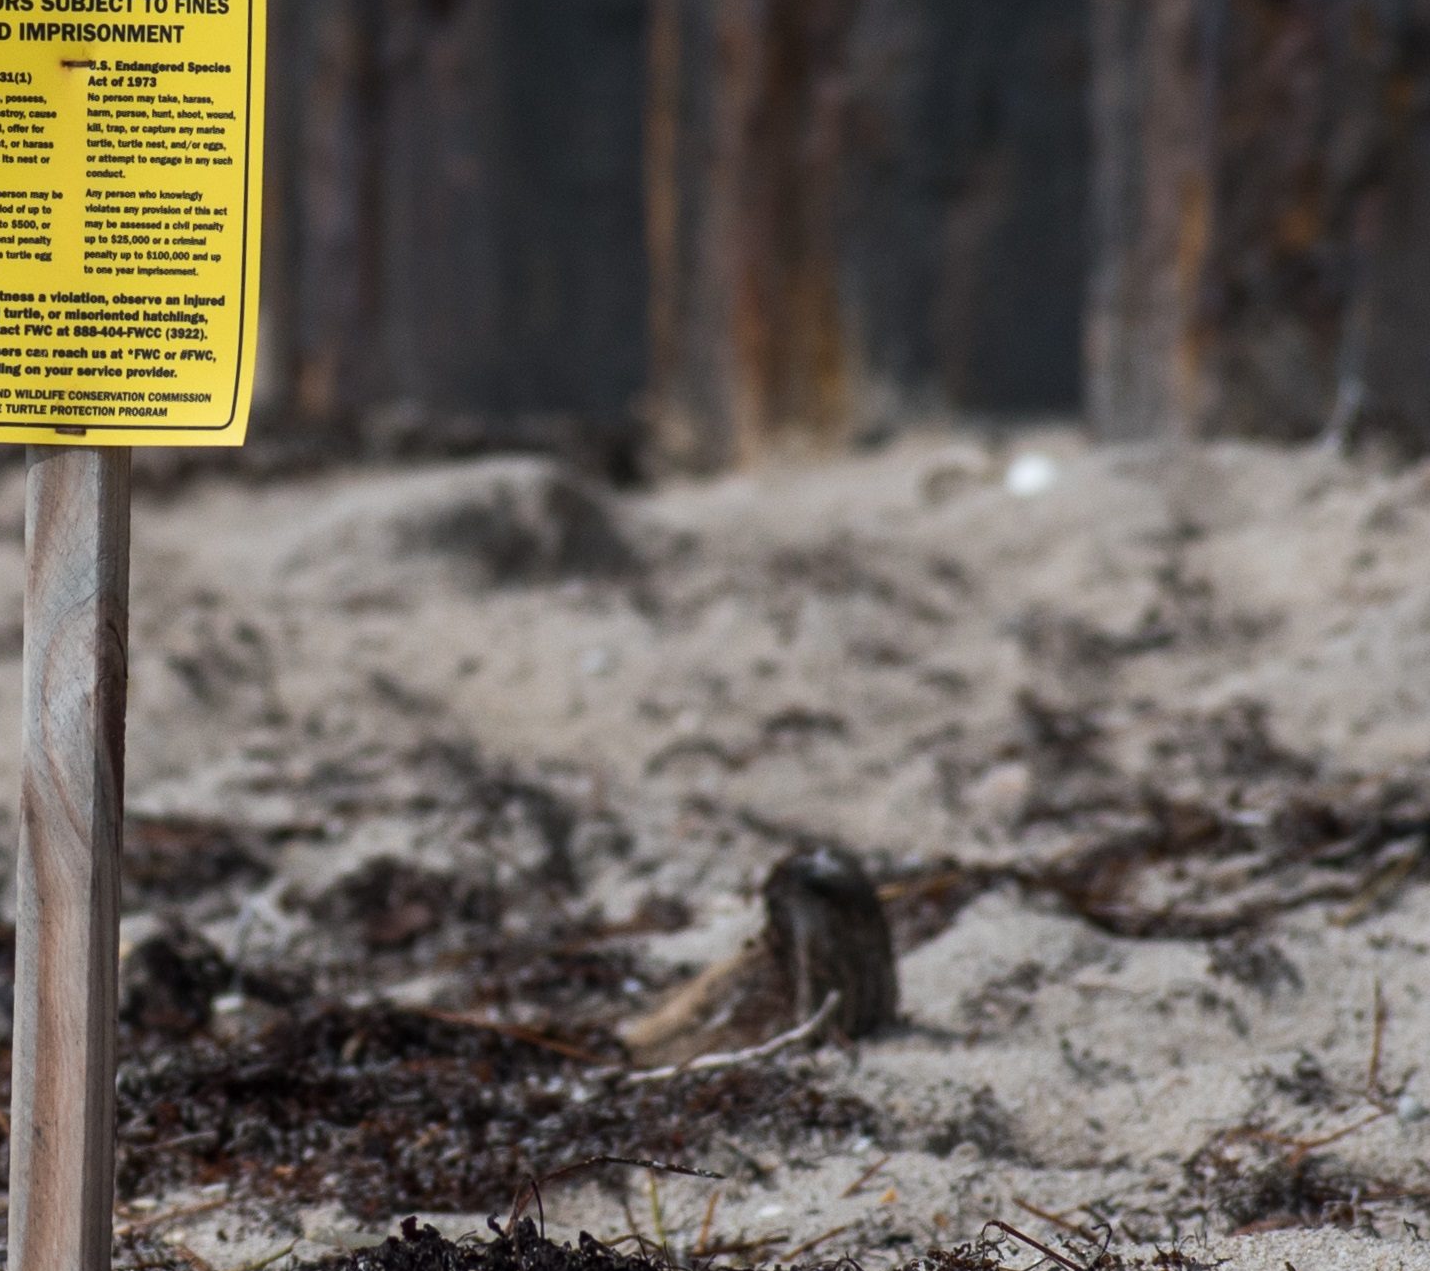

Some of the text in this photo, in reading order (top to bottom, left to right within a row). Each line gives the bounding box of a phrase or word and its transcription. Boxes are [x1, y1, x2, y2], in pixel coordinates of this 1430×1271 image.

[19, 22, 185, 43] IMPRISONMENT
[115, 60, 184, 74] Endangered
[188, 62, 231, 75] Species
[88, 76, 157, 88] Act of 1973
[87, 92, 100, 102] No
[102, 94, 134, 104] person
[136, 95, 155, 105] may
[7, 123, 29, 134] offer
[31, 124, 44, 134] for
[86, 154, 233, 166] or attempt to engage in any such
[30, 191, 49, 201] may
[52, 190, 63, 200] be
[86, 188, 203, 202] Any person who knowingly
[16, 204, 26, 214] of
[28, 206, 40, 216] up
[42, 205, 52, 214] to
[85, 203, 227, 216] violates any provision of this act
[41, 222, 51, 230] or
[84, 236, 96, 245] up
[98, 234, 108, 244] to
[111, 234, 150, 246] $25,000
[152, 237, 162, 245] or
[172, 236, 206, 246] criminal
[84, 250, 222, 263] penalty up to $100,000 and up
[84, 264, 94, 274] to
[96, 266, 113, 274] one
[115, 267, 135, 276] year
[38, 293, 46, 303] a
[50, 291, 109, 306] violation,
[112, 293, 162, 305] observe
[166, 296, 180, 306] an
[184, 294, 225, 308] injured
[4, 307, 44, 322] turtle,
[48, 310, 62, 320] or
[64, 308, 140, 322] misoriented
[143, 310, 208, 325] hatchlings,
[24, 324, 53, 336] FWC
[56, 325, 70, 337] at
[72, 325, 162, 339] 888-404-FWCC
[165, 327, 208, 342] (3922).
[25, 348, 49, 358] can
[52, 347, 89, 359] reach
[91, 350, 107, 359] us
[110, 348, 124, 360] at
[164, 351, 177, 360] or
[24, 366, 41, 375] on
[44, 366, 73, 378] your
[77, 365, 122, 377] service
[126, 366, 177, 380] provider.
[14, 389, 66, 401] WILDLIFE
[68, 390, 145, 402] CONSERVATION
[148, 392, 211, 403] COMMISSION
[6, 403, 47, 415] TURTLE
[50, 404, 115, 416] PROTECTION
[118, 406, 168, 417] PROGRAM
